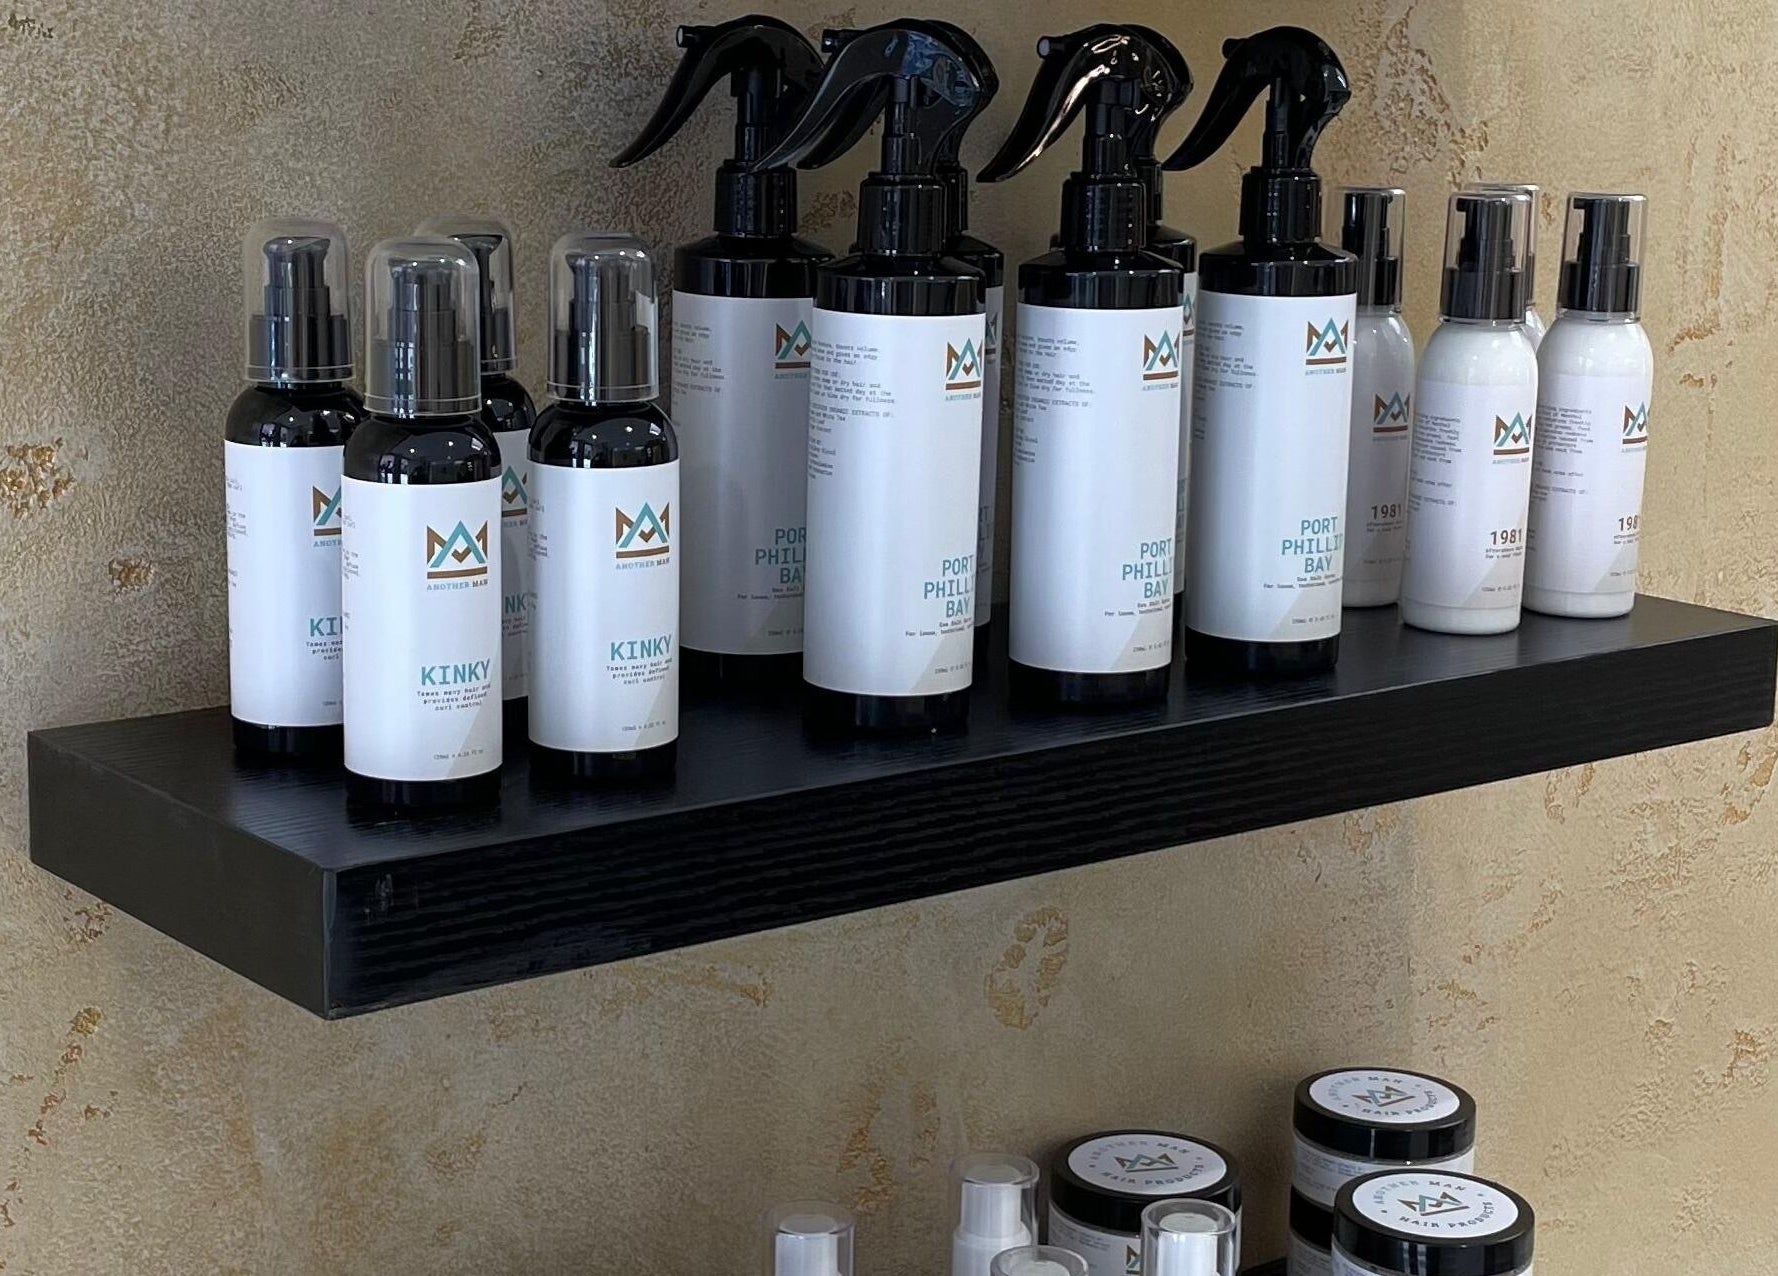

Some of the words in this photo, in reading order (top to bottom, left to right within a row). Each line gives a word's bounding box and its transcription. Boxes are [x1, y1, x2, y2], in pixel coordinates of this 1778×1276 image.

[1301, 516, 1338, 535] PORT
[1490, 528, 1522, 545] 1981
[1140, 538, 1172, 560] PORT
[615, 560, 656, 570] ANOTHER
[942, 554, 974, 577] PORT
[1304, 556, 1333, 573] BAY
[426, 581, 470, 591] ANOTHER
[1144, 579, 1169, 599] BAY
[946, 598, 970, 618] BAY
[610, 634, 672, 661] KINKY
[421, 658, 490, 686] KINKY
[1367, 1075, 1403, 1084] MAN
[1361, 1107, 1400, 1117] HAIR
[1100, 1171, 1137, 1185] HAIR
[1428, 1179, 1467, 1192] MAN
[1399, 1215, 1441, 1229] HAIR
